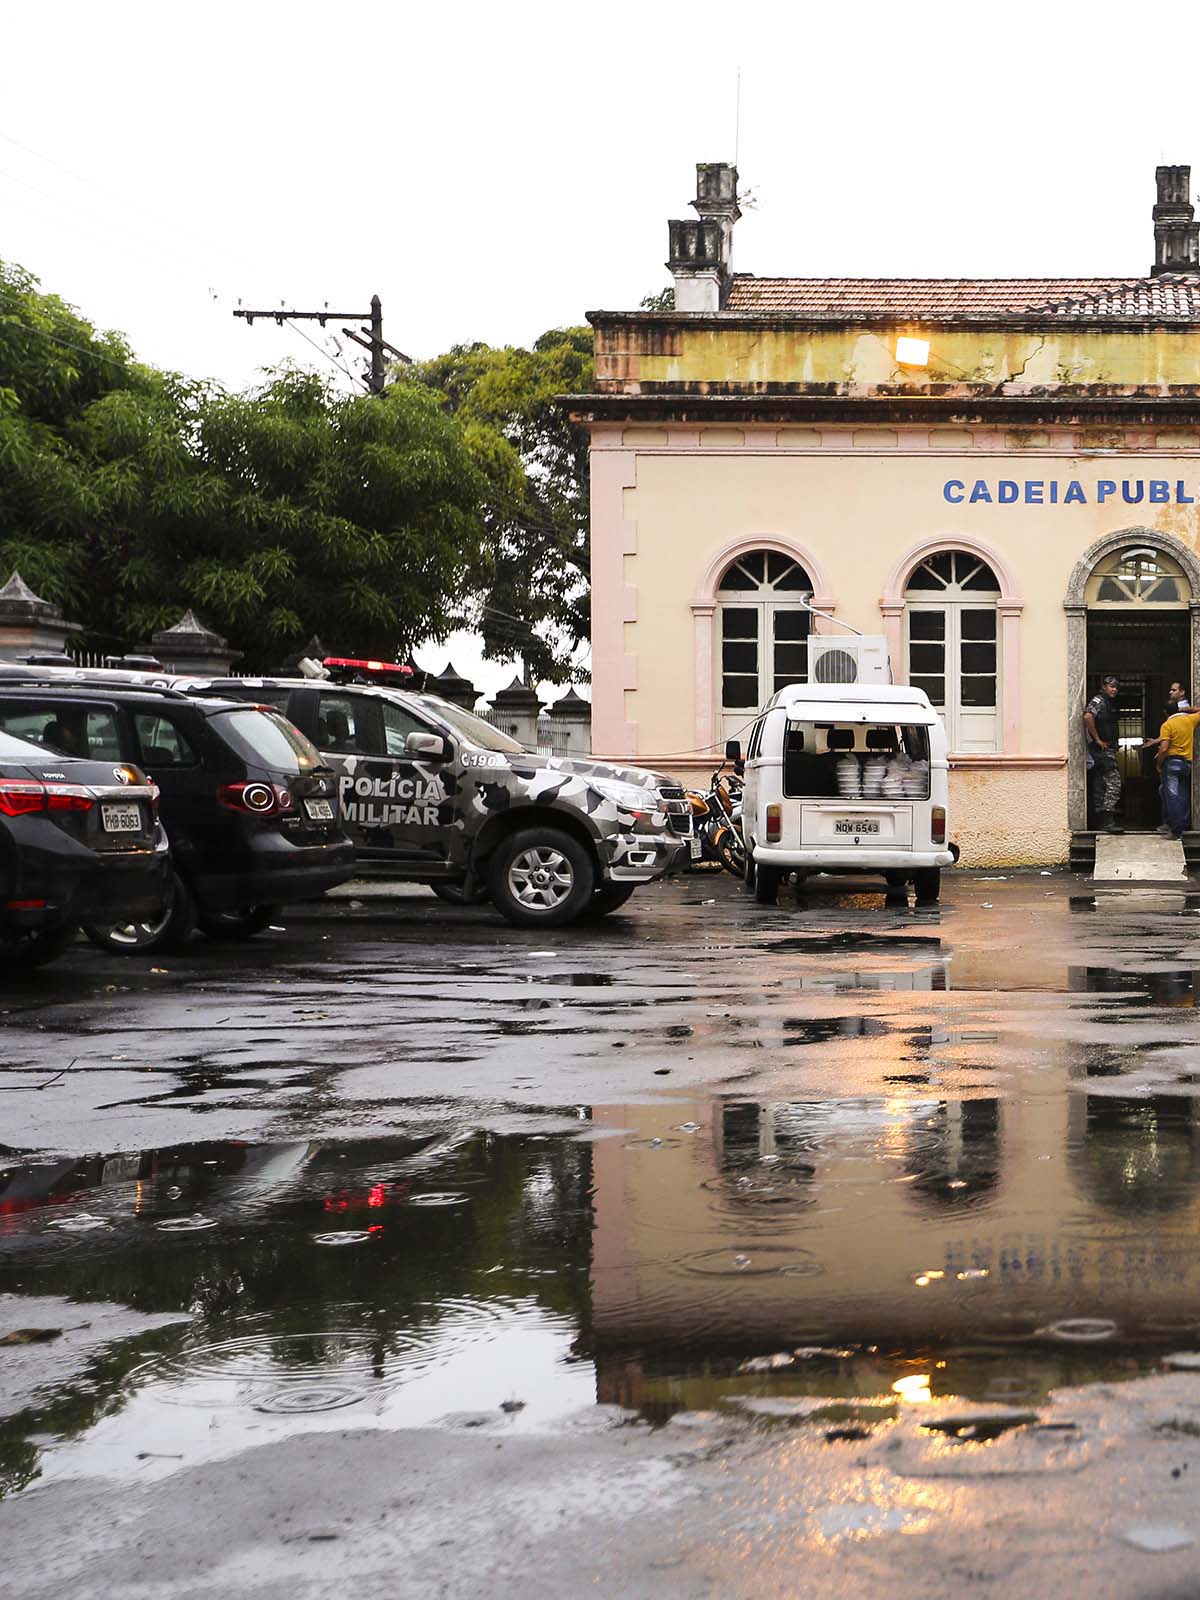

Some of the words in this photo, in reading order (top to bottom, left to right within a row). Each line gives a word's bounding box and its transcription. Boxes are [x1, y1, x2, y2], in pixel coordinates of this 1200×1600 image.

[943, 480, 1088, 504] CADEIA
[470, 754, 496, 767] 190
[339, 771, 441, 800] POLÍCIA
[342, 802, 440, 826] MILITAR
